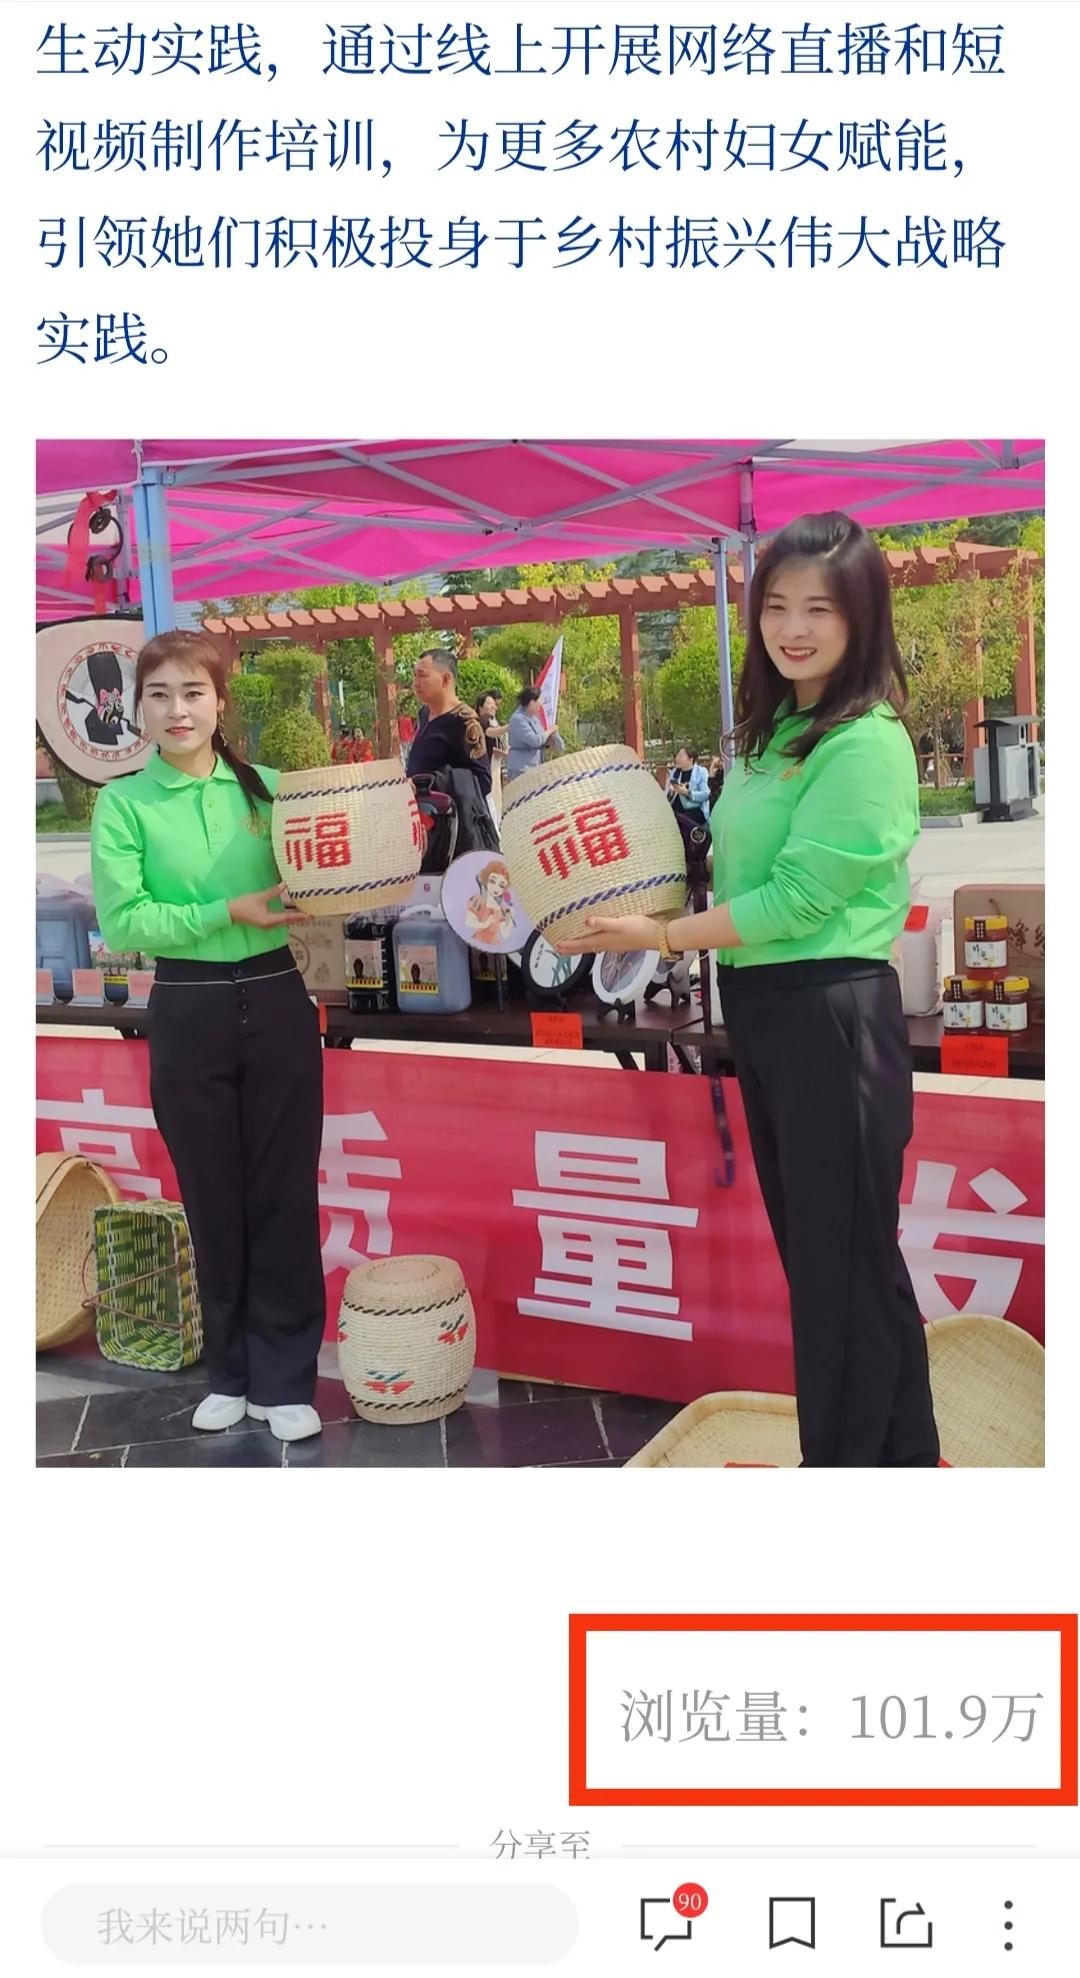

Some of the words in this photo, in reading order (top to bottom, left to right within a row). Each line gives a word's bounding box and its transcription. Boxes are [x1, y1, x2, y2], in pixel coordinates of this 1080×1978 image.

[36, 22, 1006, 82] 生动实践，通过线上开展网络直播和短
[36, 118, 964, 178] 视频制作培训，为更多农村妇女赋能，
[38, 214, 1007, 270] 引领她们积极投身于乡村振兴伟大战略
[36, 312, 168, 366] 实践。
[284, 811, 352, 871] 福
[529, 798, 632, 880] 福
[620, 1689, 1044, 1744] 浏览量：101.9万
[490, 1828, 591, 1859] 分享至
[678, 1892, 702, 1912] 90
